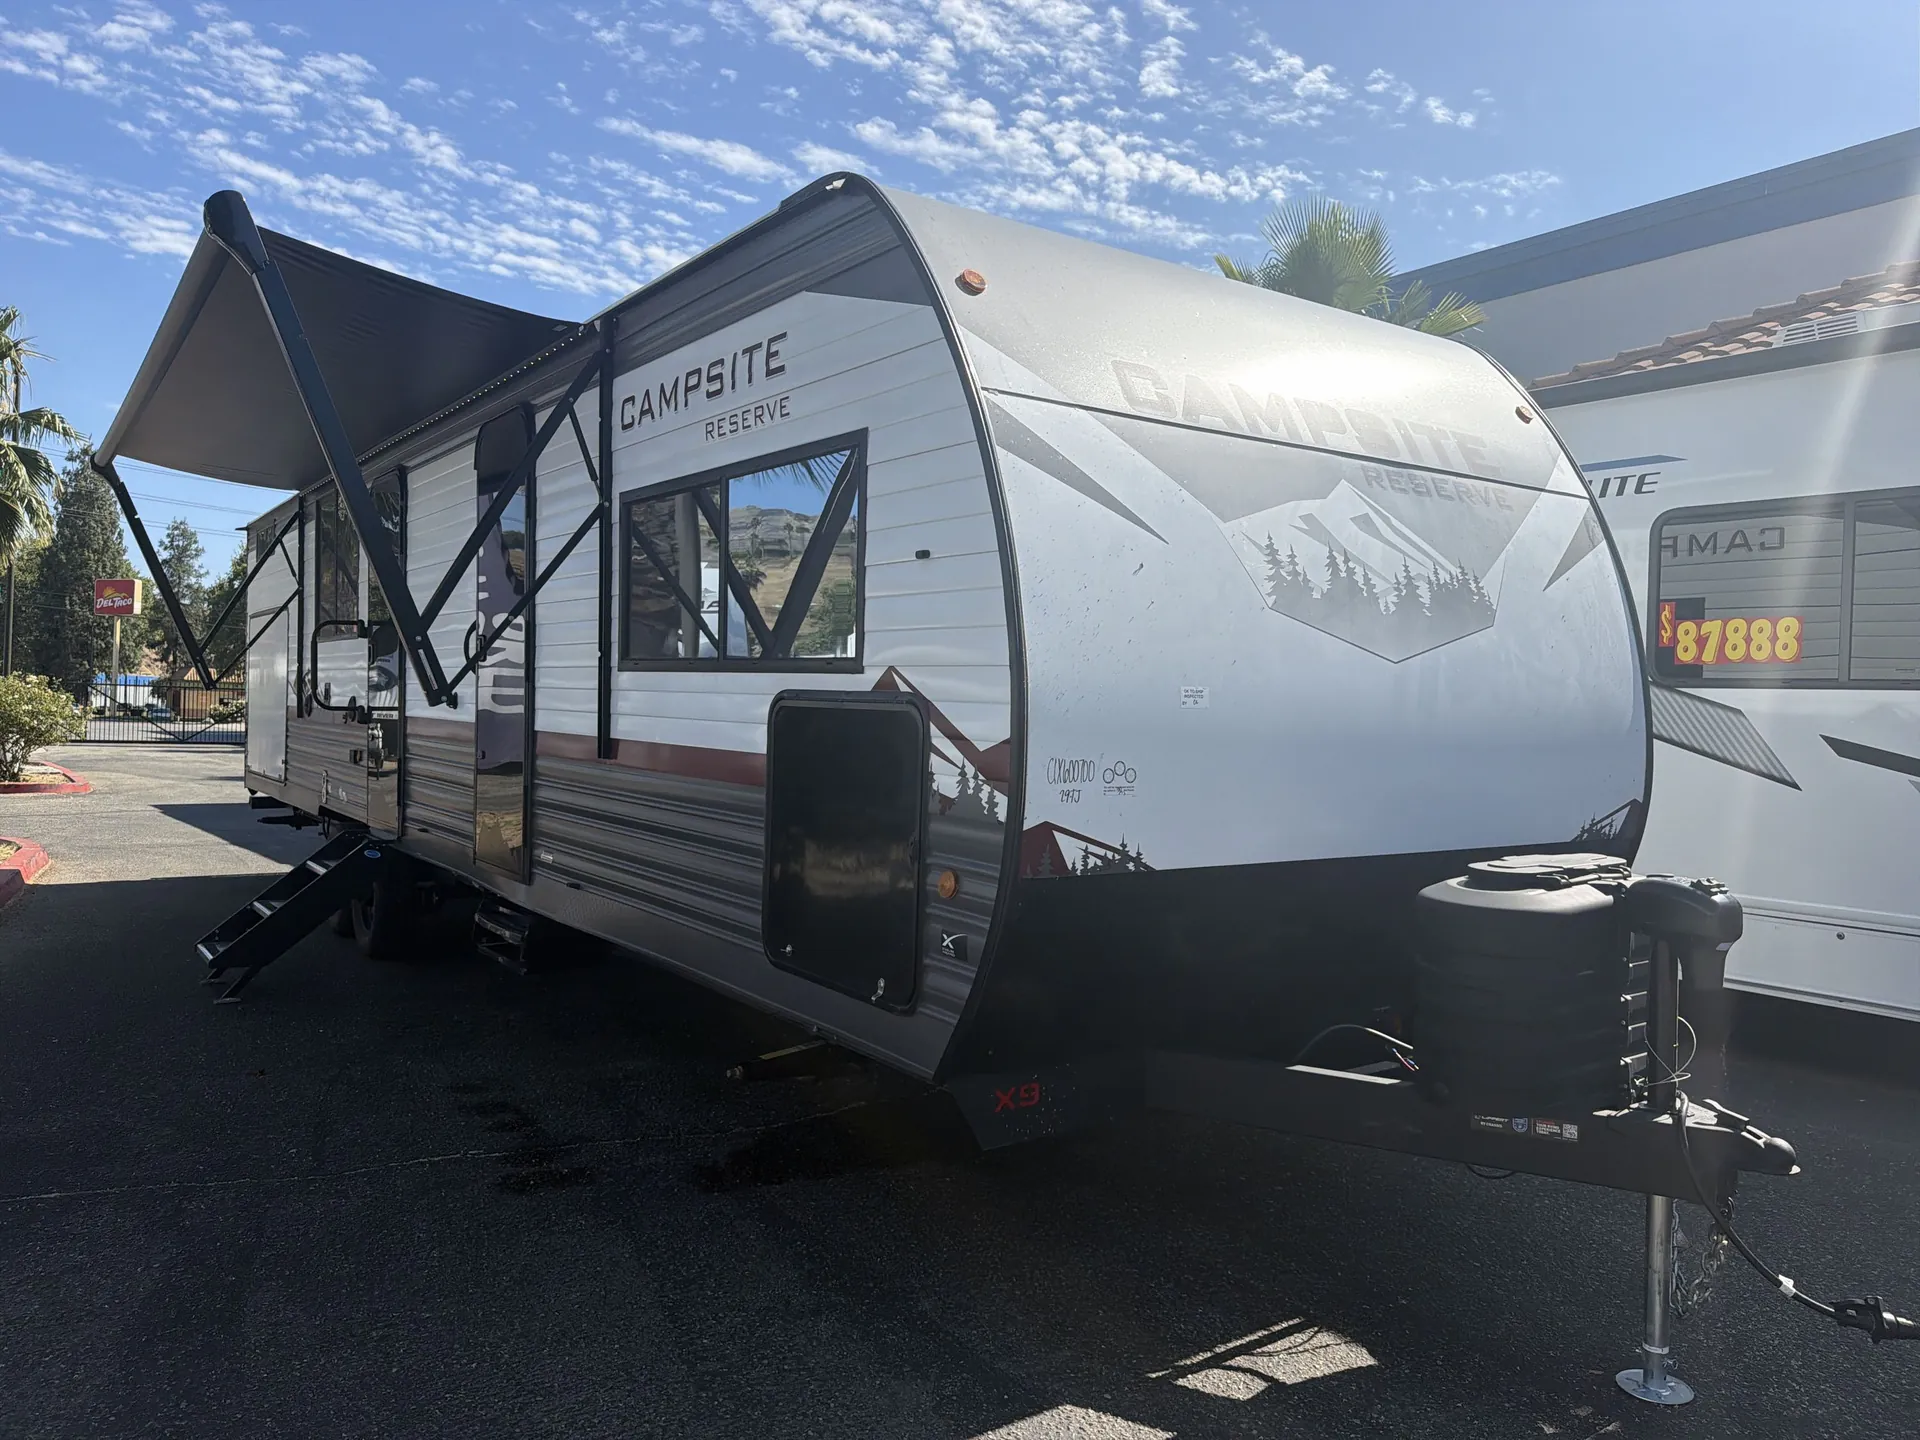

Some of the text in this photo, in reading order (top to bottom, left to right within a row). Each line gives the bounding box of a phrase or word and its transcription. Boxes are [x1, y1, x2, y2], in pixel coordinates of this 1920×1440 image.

[620, 331, 787, 431] CAMPSITE
[705, 395, 790, 441] RESERVE
[1112, 359, 1495, 475] CAMPSITE
[1360, 463, 1515, 513] RESERVE
[1588, 472, 1661, 498] ITE
